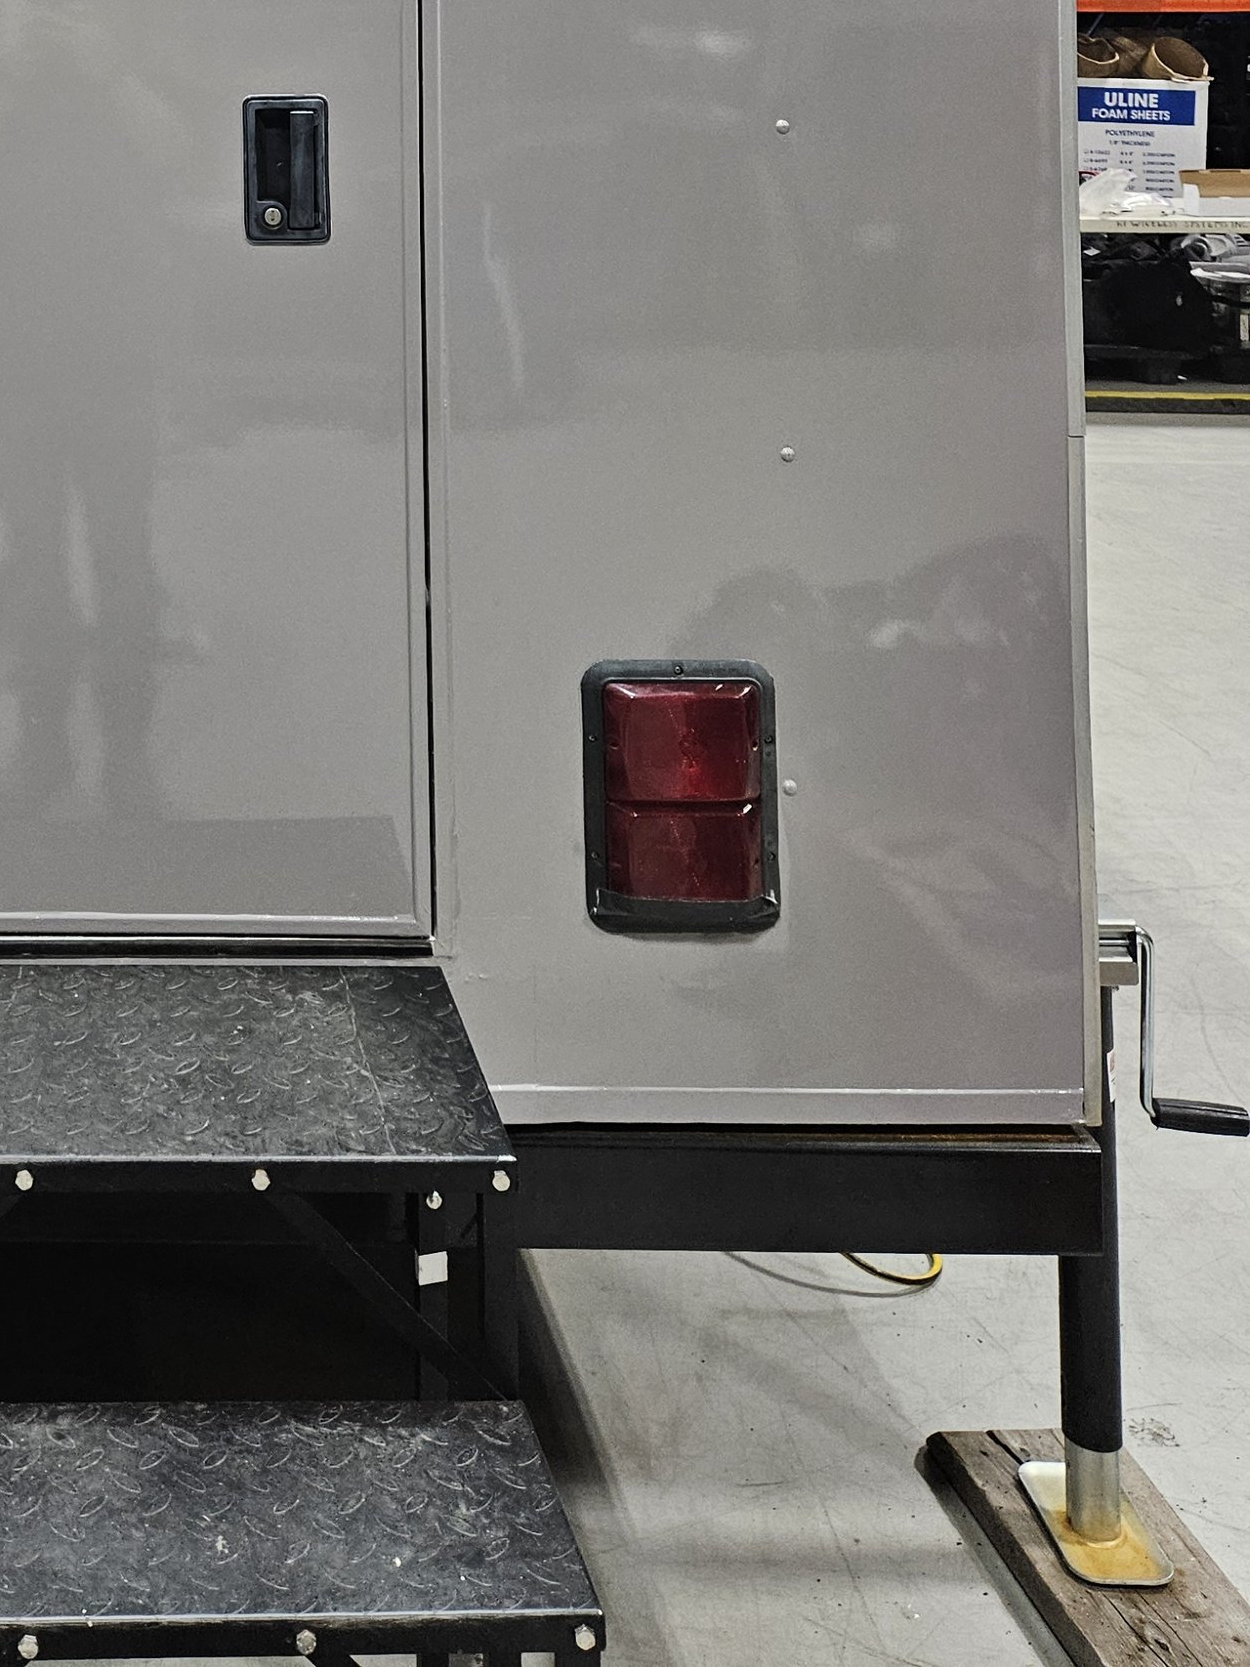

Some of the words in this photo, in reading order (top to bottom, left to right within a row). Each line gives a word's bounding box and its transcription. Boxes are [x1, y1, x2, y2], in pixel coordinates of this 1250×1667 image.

[1104, 91, 1159, 108] ULINE
[1092, 108, 1127, 119] FOAM
[1130, 109, 1171, 122] SHEETS
